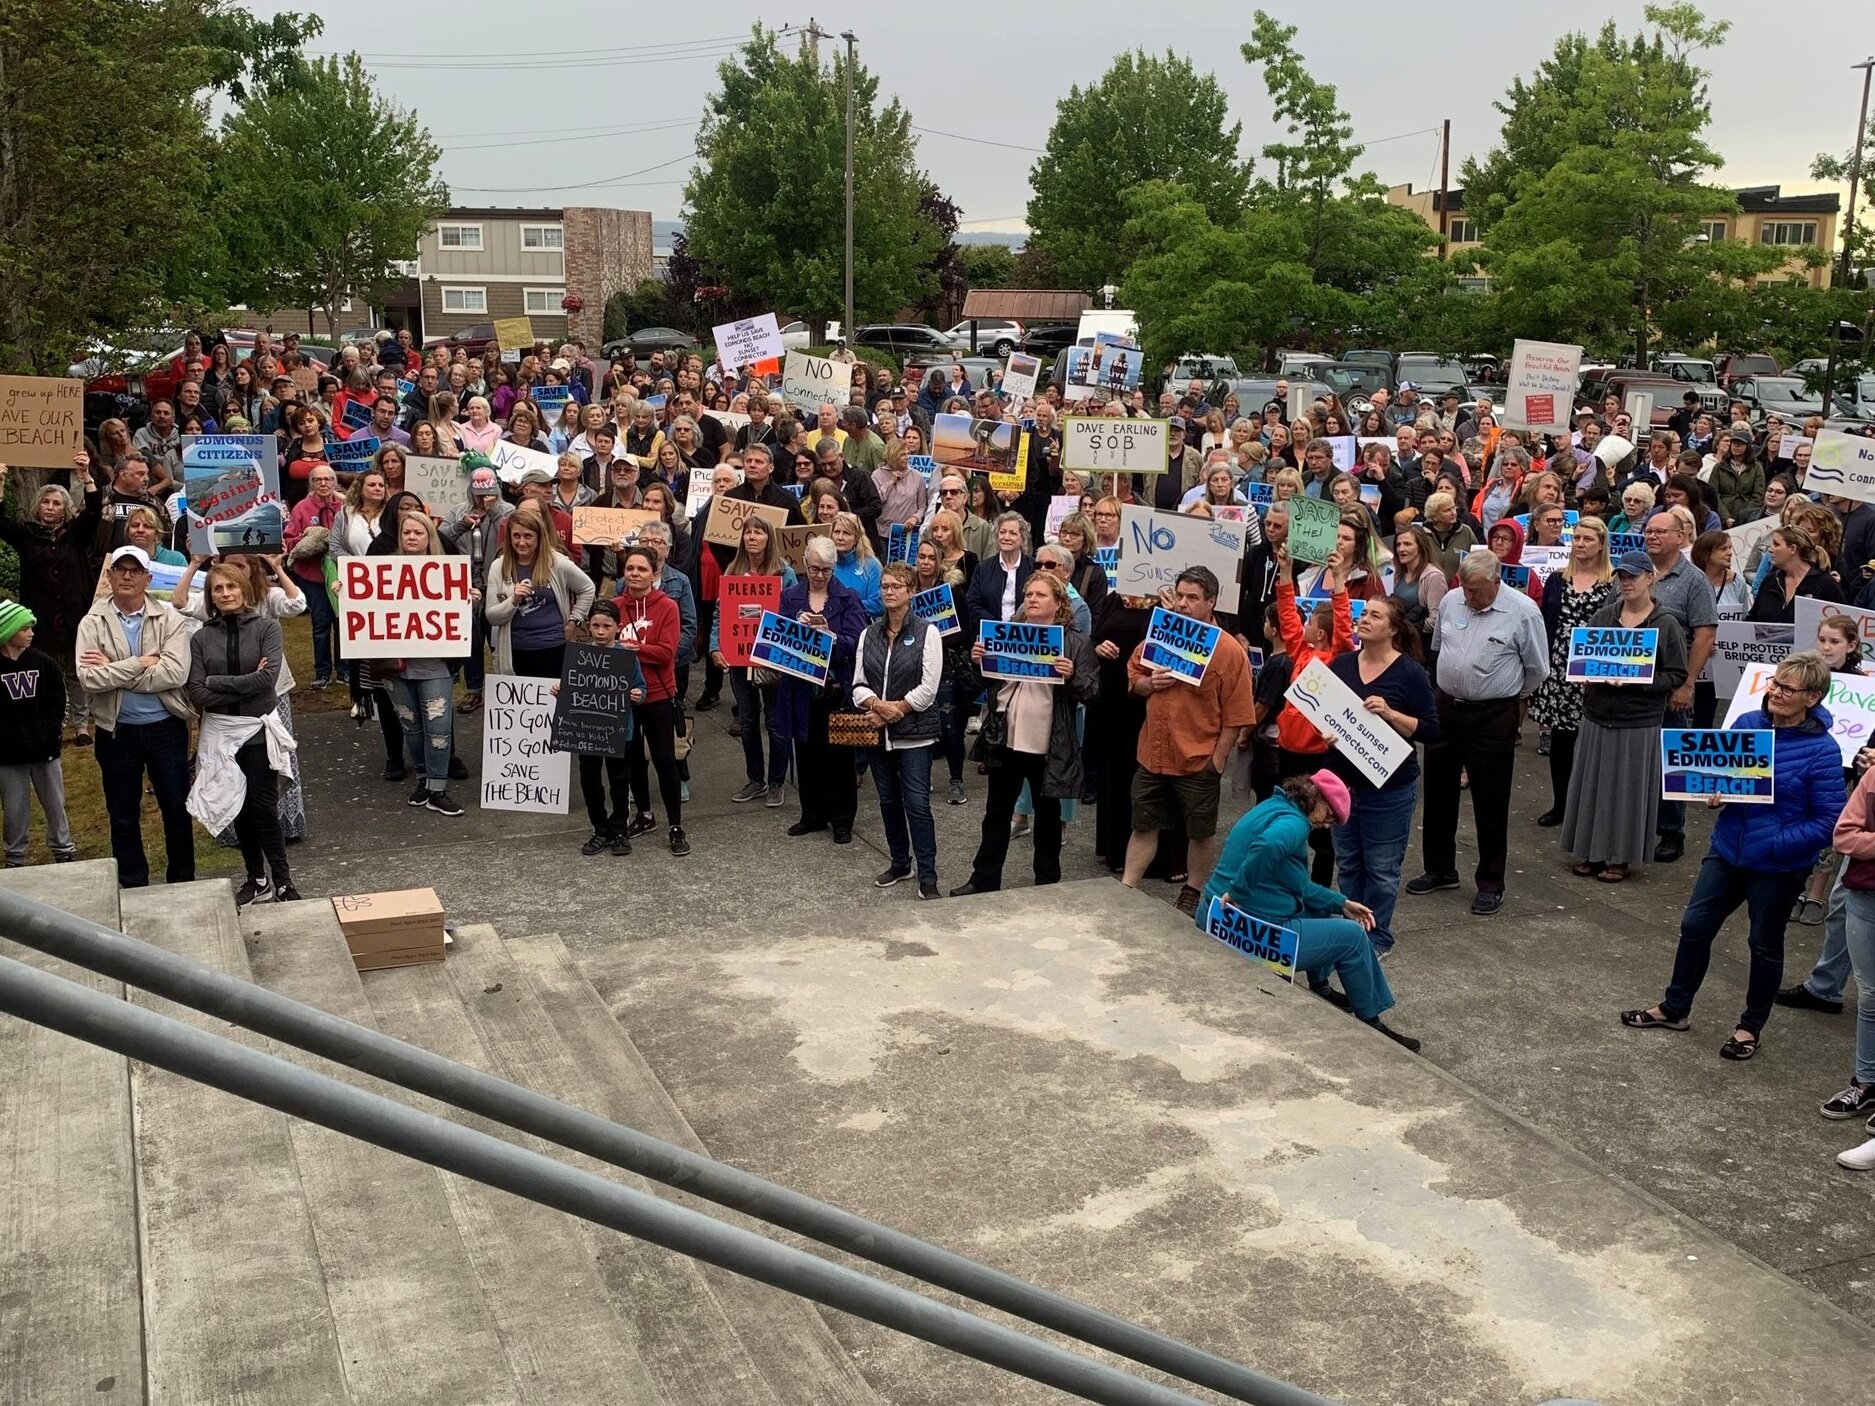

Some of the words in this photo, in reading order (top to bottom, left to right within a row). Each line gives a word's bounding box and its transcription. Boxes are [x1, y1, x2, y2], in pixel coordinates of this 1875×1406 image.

[805, 358, 832, 380] NO
[9, 388, 36, 408] grew
[40, 391, 54, 404] up
[56, 384, 82, 398] HERE
[538, 386, 562, 396] SAVE
[784, 378, 838, 404] Connector
[0, 409, 31, 424] AVE
[39, 410, 74, 426] OUR
[1076, 423, 1104, 434] DAVE
[1114, 424, 1158, 436] EARLING
[194, 436, 264, 446] EDMONDS
[333, 438, 372, 454] SAVE
[197, 450, 263, 460] CITIZENS
[330, 450, 375, 460] EDMOND
[496, 446, 526, 470] NO
[1858, 448, 1875, 460] No
[694, 470, 712, 480] PIC
[1848, 472, 1875, 485] Conn
[198, 476, 263, 510] against
[691, 486, 713, 494] DIFF
[194, 490, 277, 530] connector
[718, 499, 760, 518] SAVE
[782, 532, 802, 550] No
[1130, 518, 1176, 554] No
[1208, 523, 1240, 544] Please
[1610, 534, 1645, 548] SAV
[1548, 552, 1570, 560] TON
[1126, 563, 1189, 582] SUNSe
[346, 561, 471, 606] BEACH,
[728, 582, 772, 596] PLEASE
[913, 590, 944, 610] AVE
[915, 600, 952, 620] MONDS
[346, 610, 468, 642] PLEASE.
[732, 626, 757, 637] STO
[775, 618, 824, 647] SAVE
[994, 624, 1049, 644] SAVE
[1160, 613, 1210, 644] SAVE
[762, 626, 828, 662] EDMONDS
[984, 640, 1060, 656] EDMONDS
[1150, 626, 1211, 658] EDMONDS
[1586, 630, 1645, 646] SAVE
[1713, 641, 1738, 650] HELP
[1743, 643, 1792, 654] PROTEST
[578, 650, 611, 670] SAVE
[1574, 643, 1652, 657] EDMONDS
[1724, 652, 1764, 663] BRIDGE
[1769, 654, 1788, 664] CO
[768, 647, 816, 676] BEACH
[996, 656, 1050, 677] BEACH
[1153, 648, 1196, 676] BEACH
[1584, 660, 1640, 677] BEACH
[0, 670, 40, 700] W
[568, 669, 629, 690] EDMONDS
[496, 682, 548, 706] ONCE
[571, 692, 626, 712] BEACH!
[489, 708, 514, 731] ITS
[519, 708, 553, 734] GON
[1342, 707, 1357, 724] No
[1356, 722, 1388, 756] sunset
[490, 737, 512, 756] ITS
[518, 738, 561, 758] GON
[1324, 714, 1388, 778] connector.com
[1680, 732, 1756, 752] SAVE
[1668, 750, 1770, 768] EDMONDS
[500, 762, 540, 781] SAVE
[1685, 771, 1756, 794] BEACH
[484, 780, 514, 802] THE
[514, 782, 560, 806] BEACH
[1221, 908, 1283, 949] SAVE
[1210, 917, 1292, 968] EDMONDS
